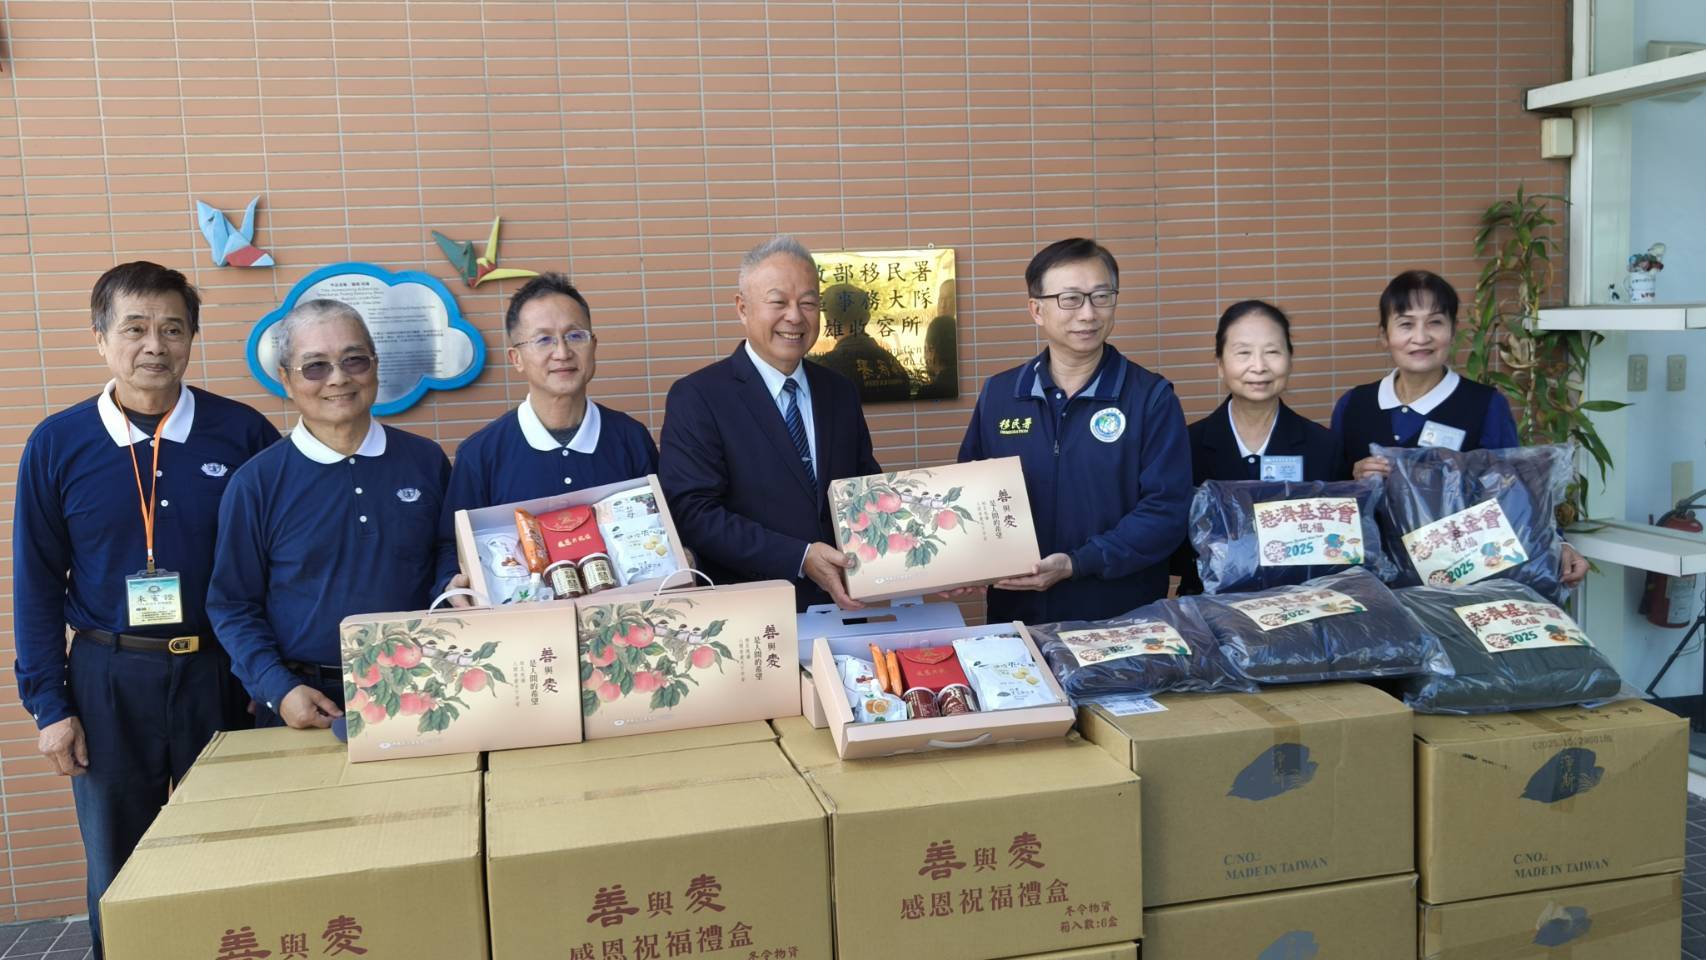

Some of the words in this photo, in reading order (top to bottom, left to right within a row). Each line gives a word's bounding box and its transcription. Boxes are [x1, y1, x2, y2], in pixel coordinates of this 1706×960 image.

[999, 417, 1033, 430] 移民署
[1258, 502, 1358, 529] 慈濟基金會
[1410, 508, 1501, 562] 慈濟基金會
[1285, 542, 1314, 558] 2025
[1447, 559, 1475, 584] 2025
[1509, 630, 1538, 644] 2025
[1225, 866, 1261, 880] MADE
[1263, 864, 1277, 876] IN
[1280, 856, 1329, 873] TAIWAN
[1514, 865, 1549, 879] MADE
[1551, 863, 1563, 875] IN
[1567, 858, 1610, 873] TAIWAN
[900, 878, 1070, 921] 感恩祝福禮盒
[1064, 900, 1113, 918] 冬令物資
[569, 920, 755, 960] 感恩祝福禮盒
